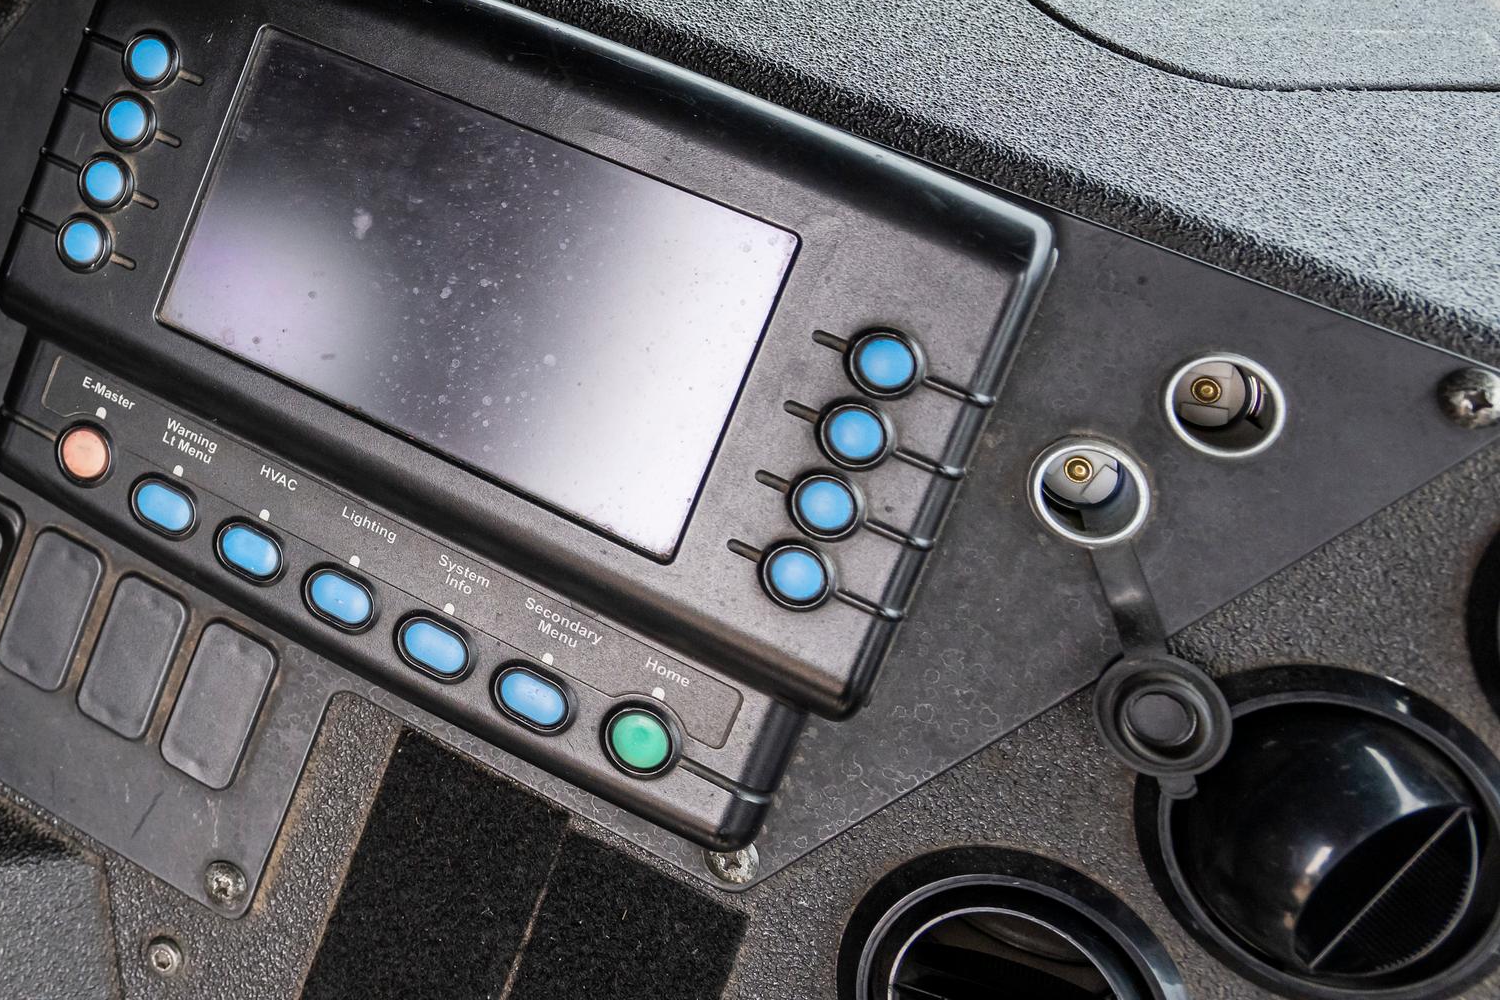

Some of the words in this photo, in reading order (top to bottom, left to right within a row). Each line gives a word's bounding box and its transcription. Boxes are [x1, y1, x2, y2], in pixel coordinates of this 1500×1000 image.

[82, 376, 136, 410] E-Master
[162, 431, 179, 448] Lt
[177, 438, 212, 464] Menu
[166, 417, 218, 453] Warning
[260, 465, 298, 491] HVAC
[342, 506, 397, 544] Lighting
[438, 554, 490, 588] System
[445, 573, 472, 595] Info
[524, 597, 602, 645] Secondary
[537, 619, 578, 648] Menu
[645, 656, 690, 687] Home
